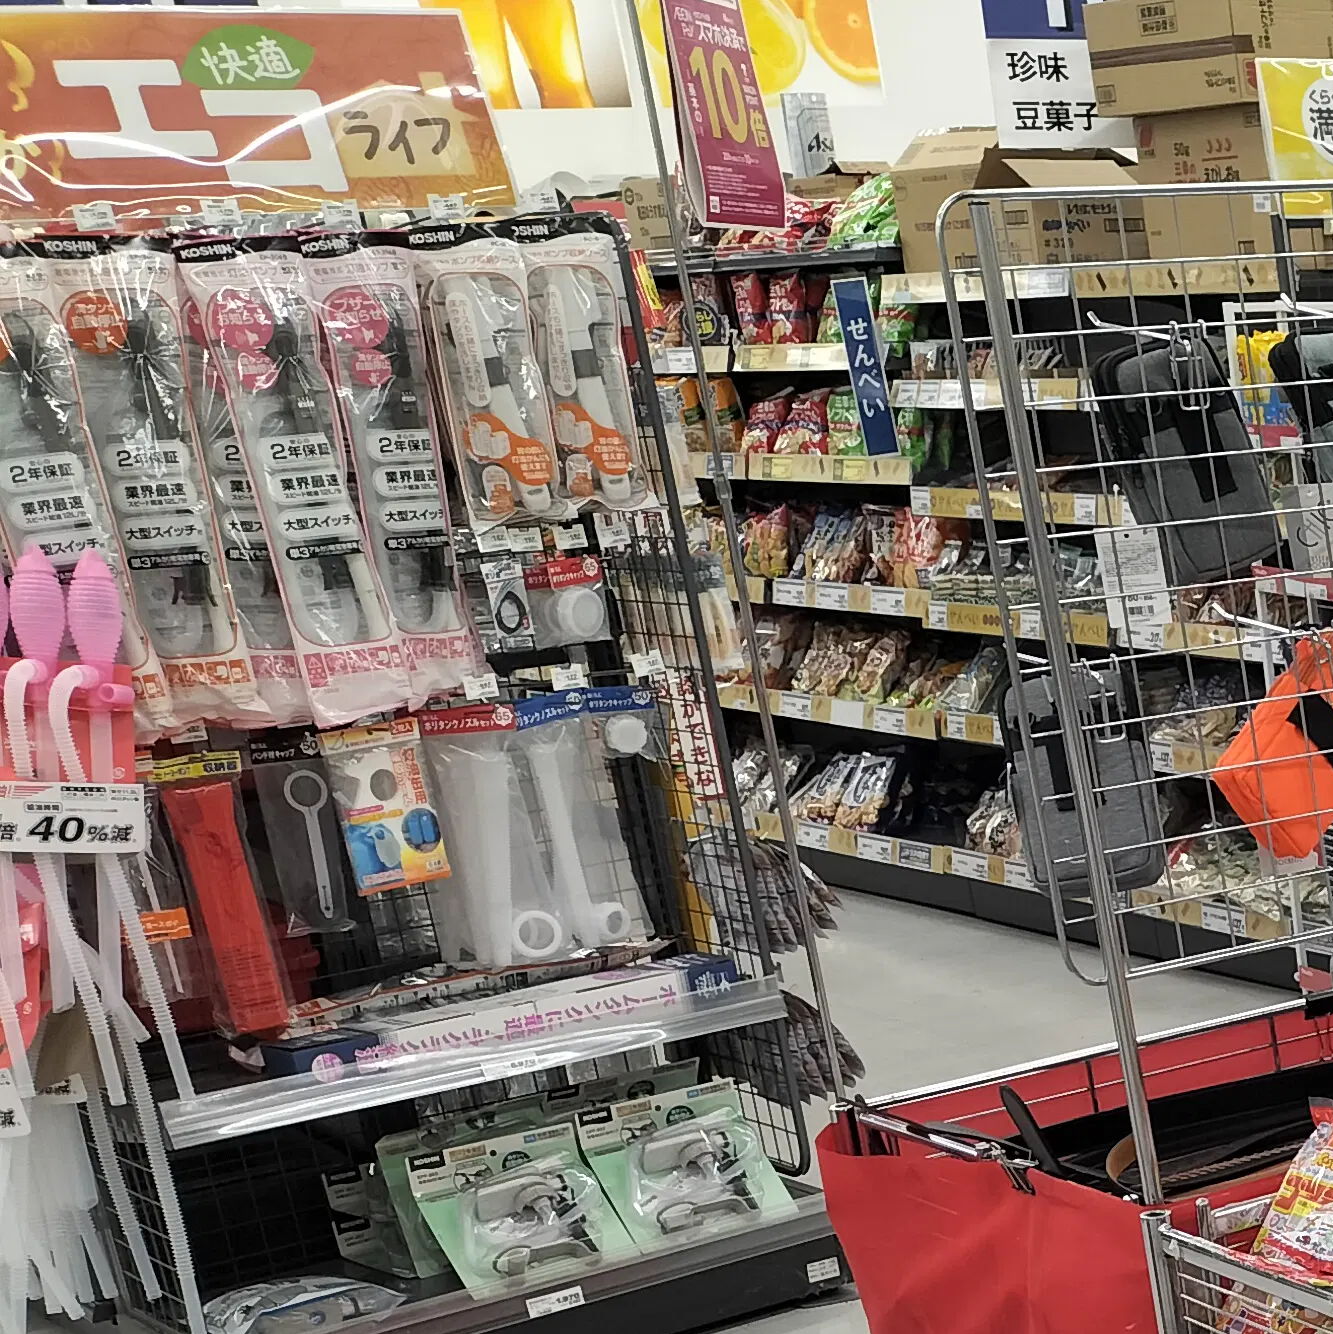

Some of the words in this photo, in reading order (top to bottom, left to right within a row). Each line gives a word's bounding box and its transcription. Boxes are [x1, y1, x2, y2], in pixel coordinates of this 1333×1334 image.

[200, 35, 301, 84] 快適
[1006, 51, 1070, 82] 珍味
[690, 46, 748, 143] 10
[54, 59, 349, 191] エコ
[1012, 100, 1099, 132] 豆菓子
[343, 110, 451, 161] ライフ
[750, 109, 769, 148] 倍
[44, 240, 97, 254] KOSHIN
[300, 237, 349, 254] KOSHIN
[408, 230, 455, 244] KOSHIN
[180, 245, 235, 260] KOSHIN
[847, 315, 886, 418] せんべい
[10, 465, 75, 484] 2年保証
[280, 472, 339, 492] 業界最速
[125, 483, 186, 501] 業界最速
[21, 495, 84, 514] 業界最速
[125, 522, 197, 541] 大型スイッチ
[283, 514, 353, 533] 大型スイッチ
[28, 815, 134, 843] 40%減
